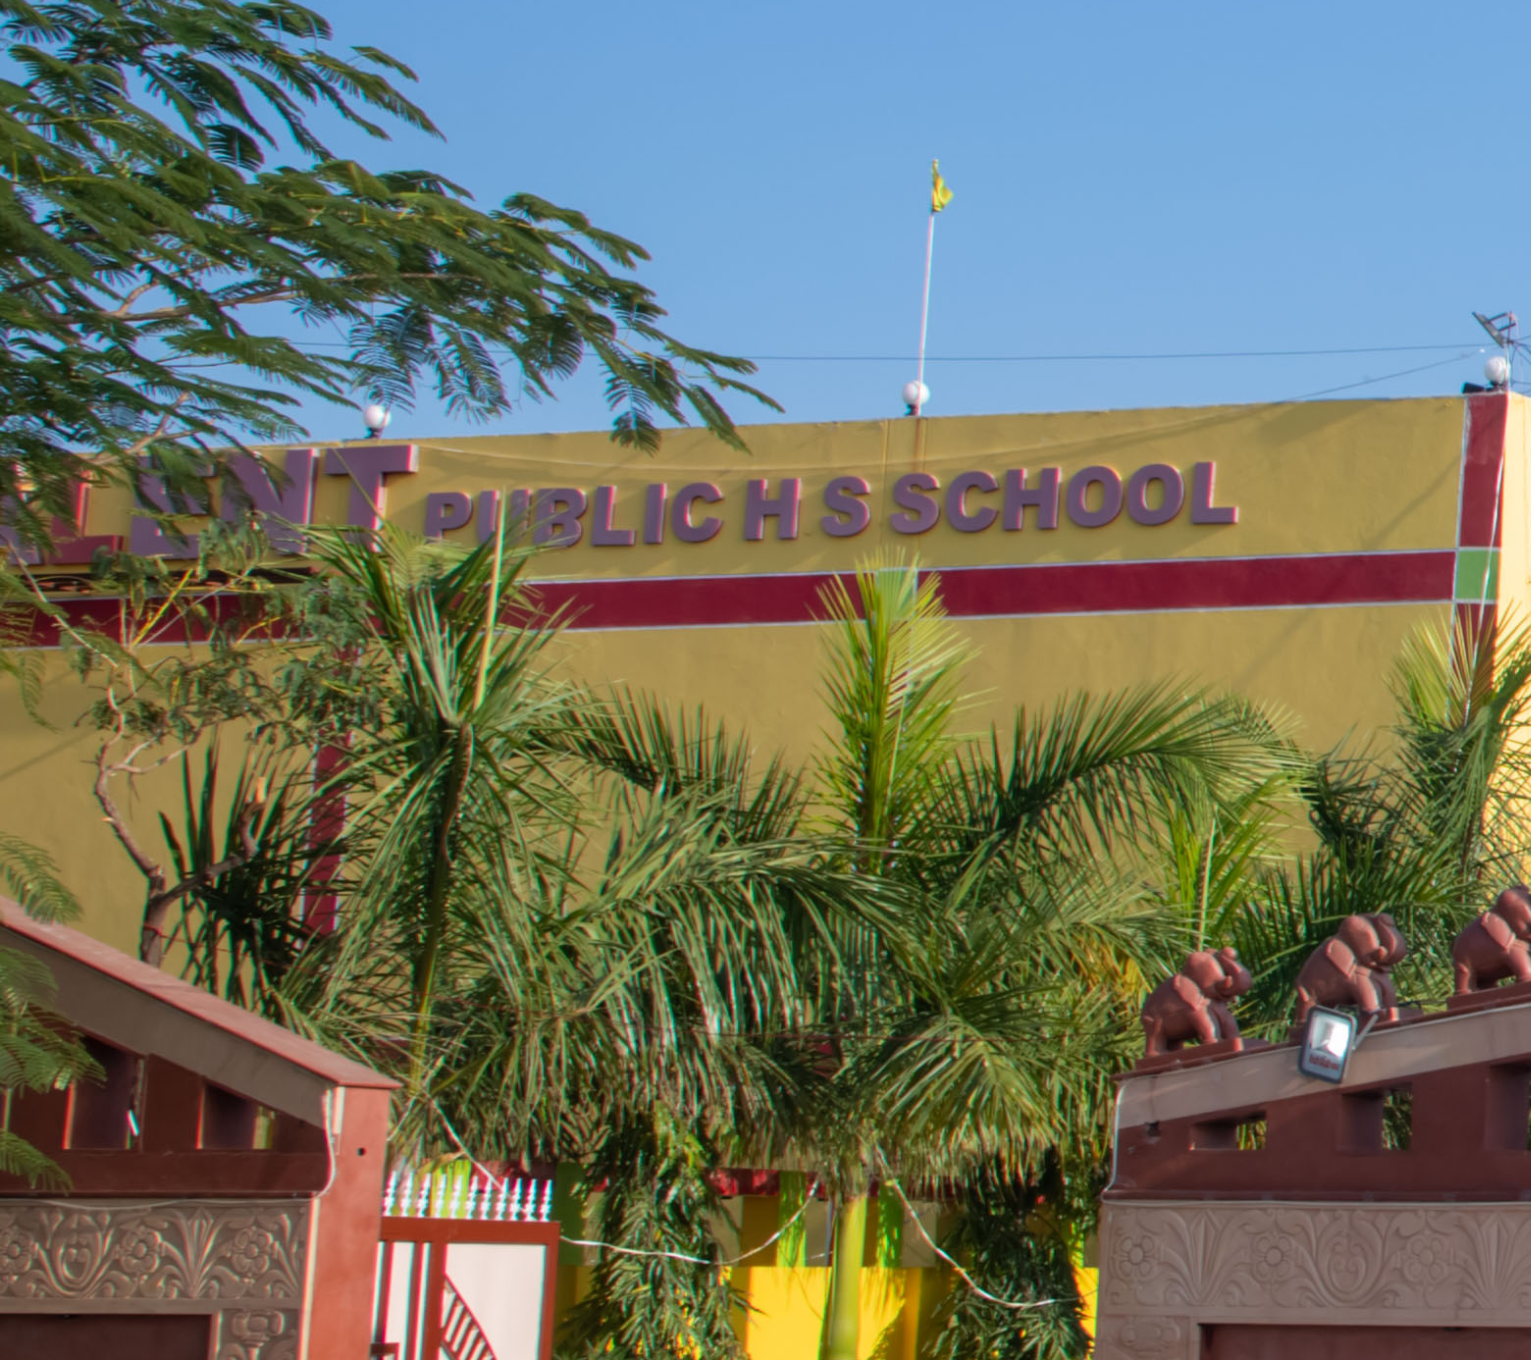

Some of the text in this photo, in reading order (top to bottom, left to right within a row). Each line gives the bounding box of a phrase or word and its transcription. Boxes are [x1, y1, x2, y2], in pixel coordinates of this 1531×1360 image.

[425, 482, 723, 547] PUBLIC
[744, 477, 800, 540] H
[821, 475, 870, 537] S
[890, 461, 1239, 535] SCHOOL
